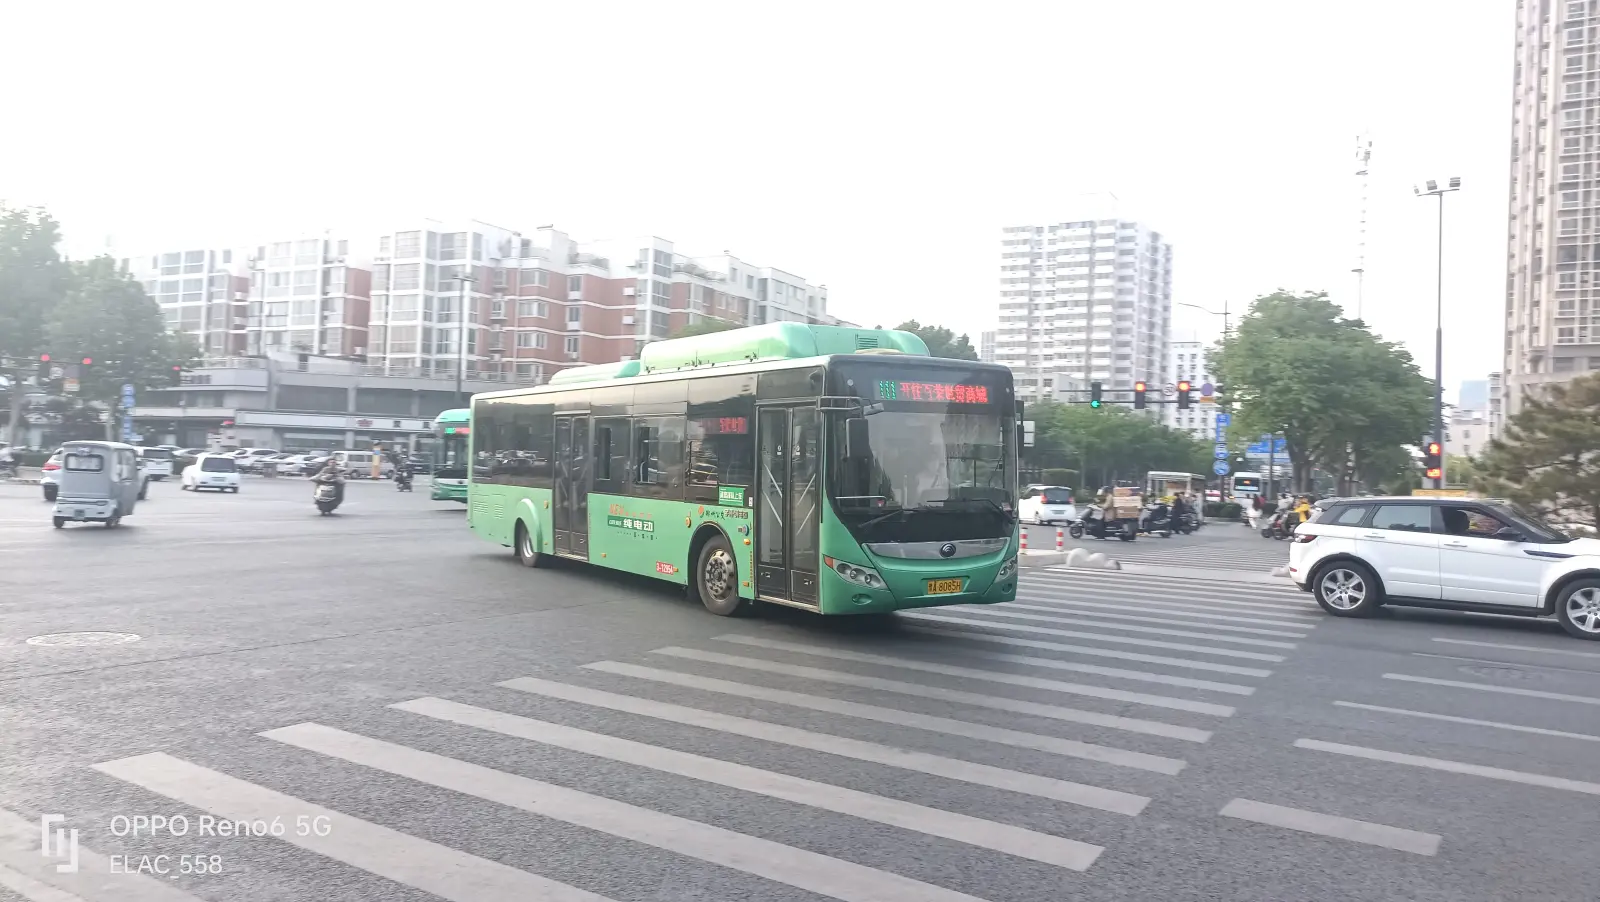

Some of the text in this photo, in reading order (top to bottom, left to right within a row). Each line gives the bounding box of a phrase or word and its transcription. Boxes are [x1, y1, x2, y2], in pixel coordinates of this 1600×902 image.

[879, 380, 896, 400] 111
[623, 518, 654, 532] 纯电动
